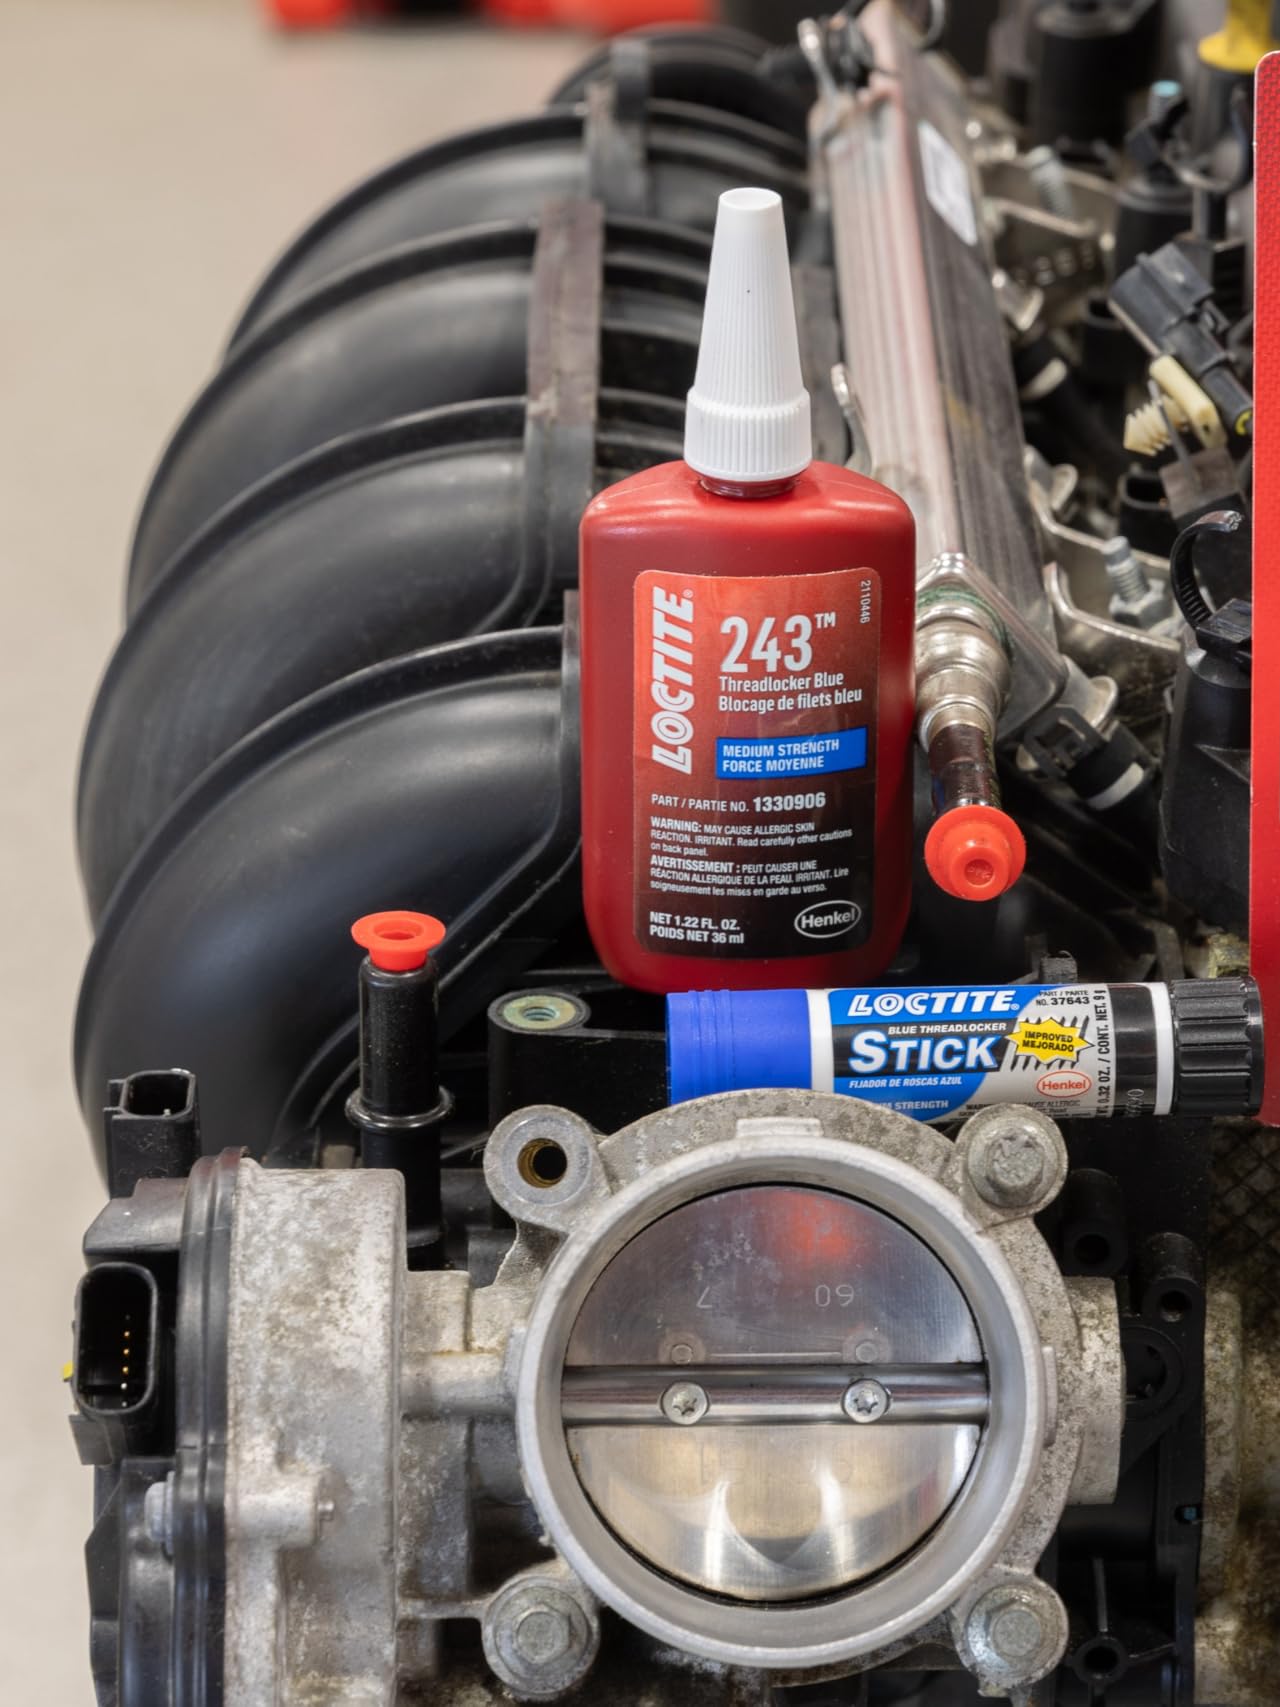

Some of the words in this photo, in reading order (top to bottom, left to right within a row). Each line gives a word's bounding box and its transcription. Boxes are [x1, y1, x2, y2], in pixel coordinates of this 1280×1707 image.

[859, 579, 871, 624] 2110446
[718, 675, 812, 693] Threadlocker
[814, 672, 844, 688] Blue
[718, 695, 774, 714] Blocage
[777, 695, 794, 711] de
[797, 691, 832, 709] filets
[834, 688, 863, 705] bleu
[722, 744, 775, 758] MEDIUM
[777, 738, 840, 757] STRENGTH
[722, 759, 762, 773] FORCE
[766, 755, 824, 773] MOYENNE
[651, 793, 679, 806] PART
[689, 798, 728, 812] PARTIE
[730, 799, 750, 812] NO.
[753, 792, 827, 812] 1330906
[650, 816, 702, 833] WARNING:
[703, 824, 724, 834] MAY
[724, 825, 753, 835] CAUSE
[754, 823, 794, 835] ALLERGIC
[795, 821, 816, 833] SKIN
[650, 829, 693, 843] REACTION.
[694, 835, 735, 847] IRRITANT.
[737, 837, 759, 847] Read
[760, 835, 795, 847] carefully
[796, 833, 819, 844] other
[819, 828, 853, 842] cautions
[650, 842, 661, 850] on
[662, 843, 682, 853] back
[683, 847, 709, 857] panel.
[650, 854, 735, 873] AVERTISSEMENT
[742, 863, 763, 874] PEUT
[765, 862, 798, 873] CAUSER
[799, 860, 817, 871] UNE
[691, 872, 743, 885] ALLERGIQUE
[744, 875, 756, 885] DE
[757, 875, 769, 885] LA
[834, 867, 849, 878] Lire
[650, 880, 711, 895] soigneusement
[712, 886, 725, 895] les
[753, 888, 764, 896] en
[765, 885, 789, 898] garde
[790, 886, 801, 894] au
[650, 911, 671, 925] NET
[675, 914, 699, 928] 1.22
[701, 917, 718, 930] FL.
[721, 919, 740, 930] OZ.
[801, 908, 855, 929] Henkel
[650, 924, 685, 940] POIDS
[686, 928, 709, 942] NET
[711, 931, 727, 943] 36
[729, 932, 744, 944] ml
[1051, 996, 1090, 1006] 37643
[1094, 1002, 1108, 1021] NET.
[888, 1023, 917, 1035] BLUE
[919, 1021, 1007, 1034] THREADLOCKER
[1025, 1031, 1073, 1043] IMPROVED
[1022, 1040, 1074, 1053] MEJORADO
[1097, 1024, 1110, 1055] CONT.
[849, 1030, 1000, 1074] STICK
[849, 1078, 887, 1089] FIJADOR
[889, 1077, 901, 1088] DE
[903, 1077, 938, 1087] ROSCAS
[940, 1075, 963, 1086] AZUL
[1041, 1079, 1086, 1091] Henkel
[895, 1100, 949, 1110] STRENGTH
